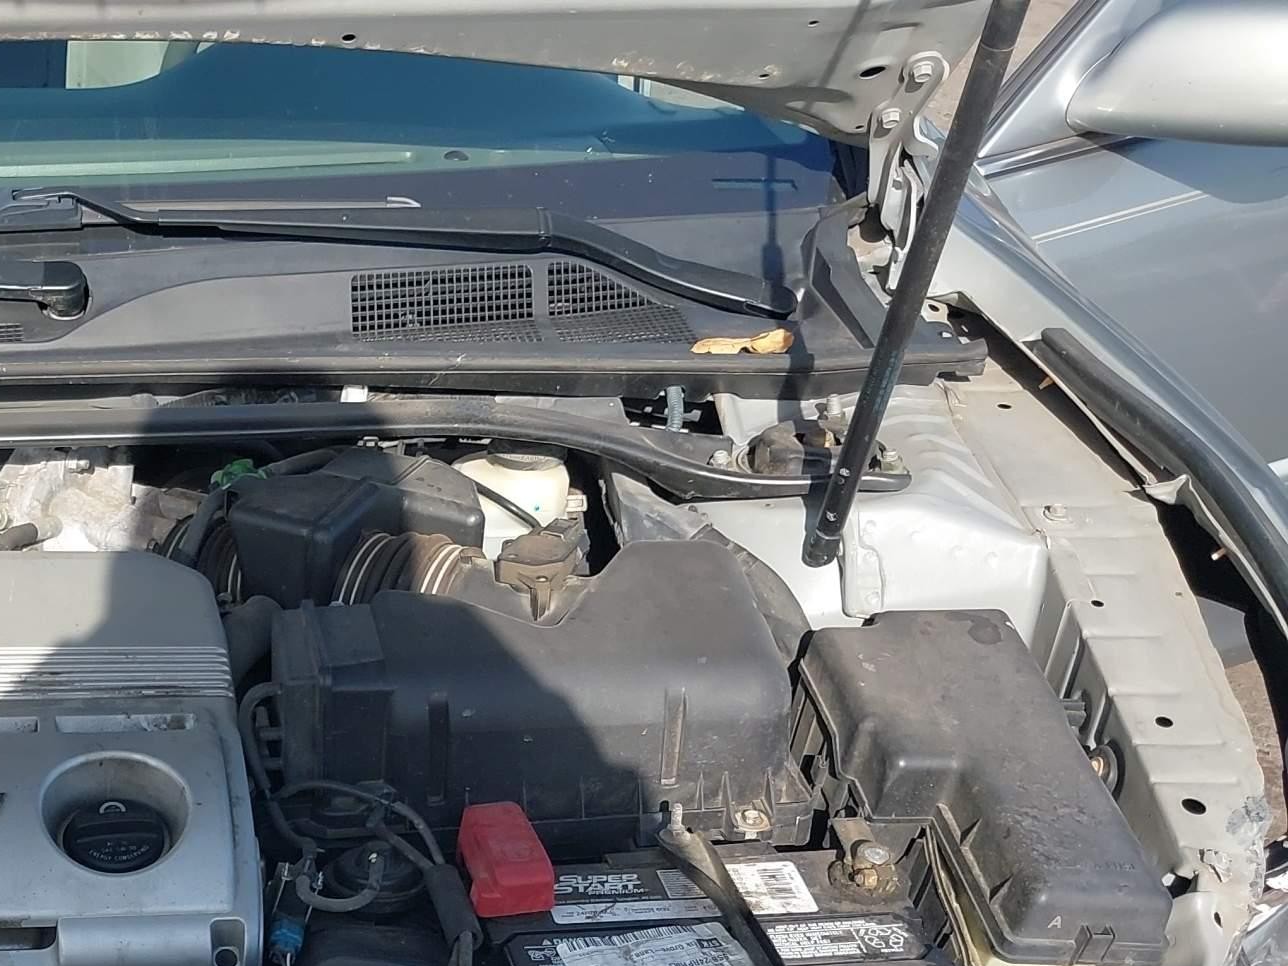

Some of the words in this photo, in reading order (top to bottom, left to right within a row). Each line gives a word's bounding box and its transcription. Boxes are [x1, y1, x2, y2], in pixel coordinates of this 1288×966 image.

[559, 873, 638, 885] SUPER
[554, 882, 641, 895] START
[1047, 915, 1062, 929] A
